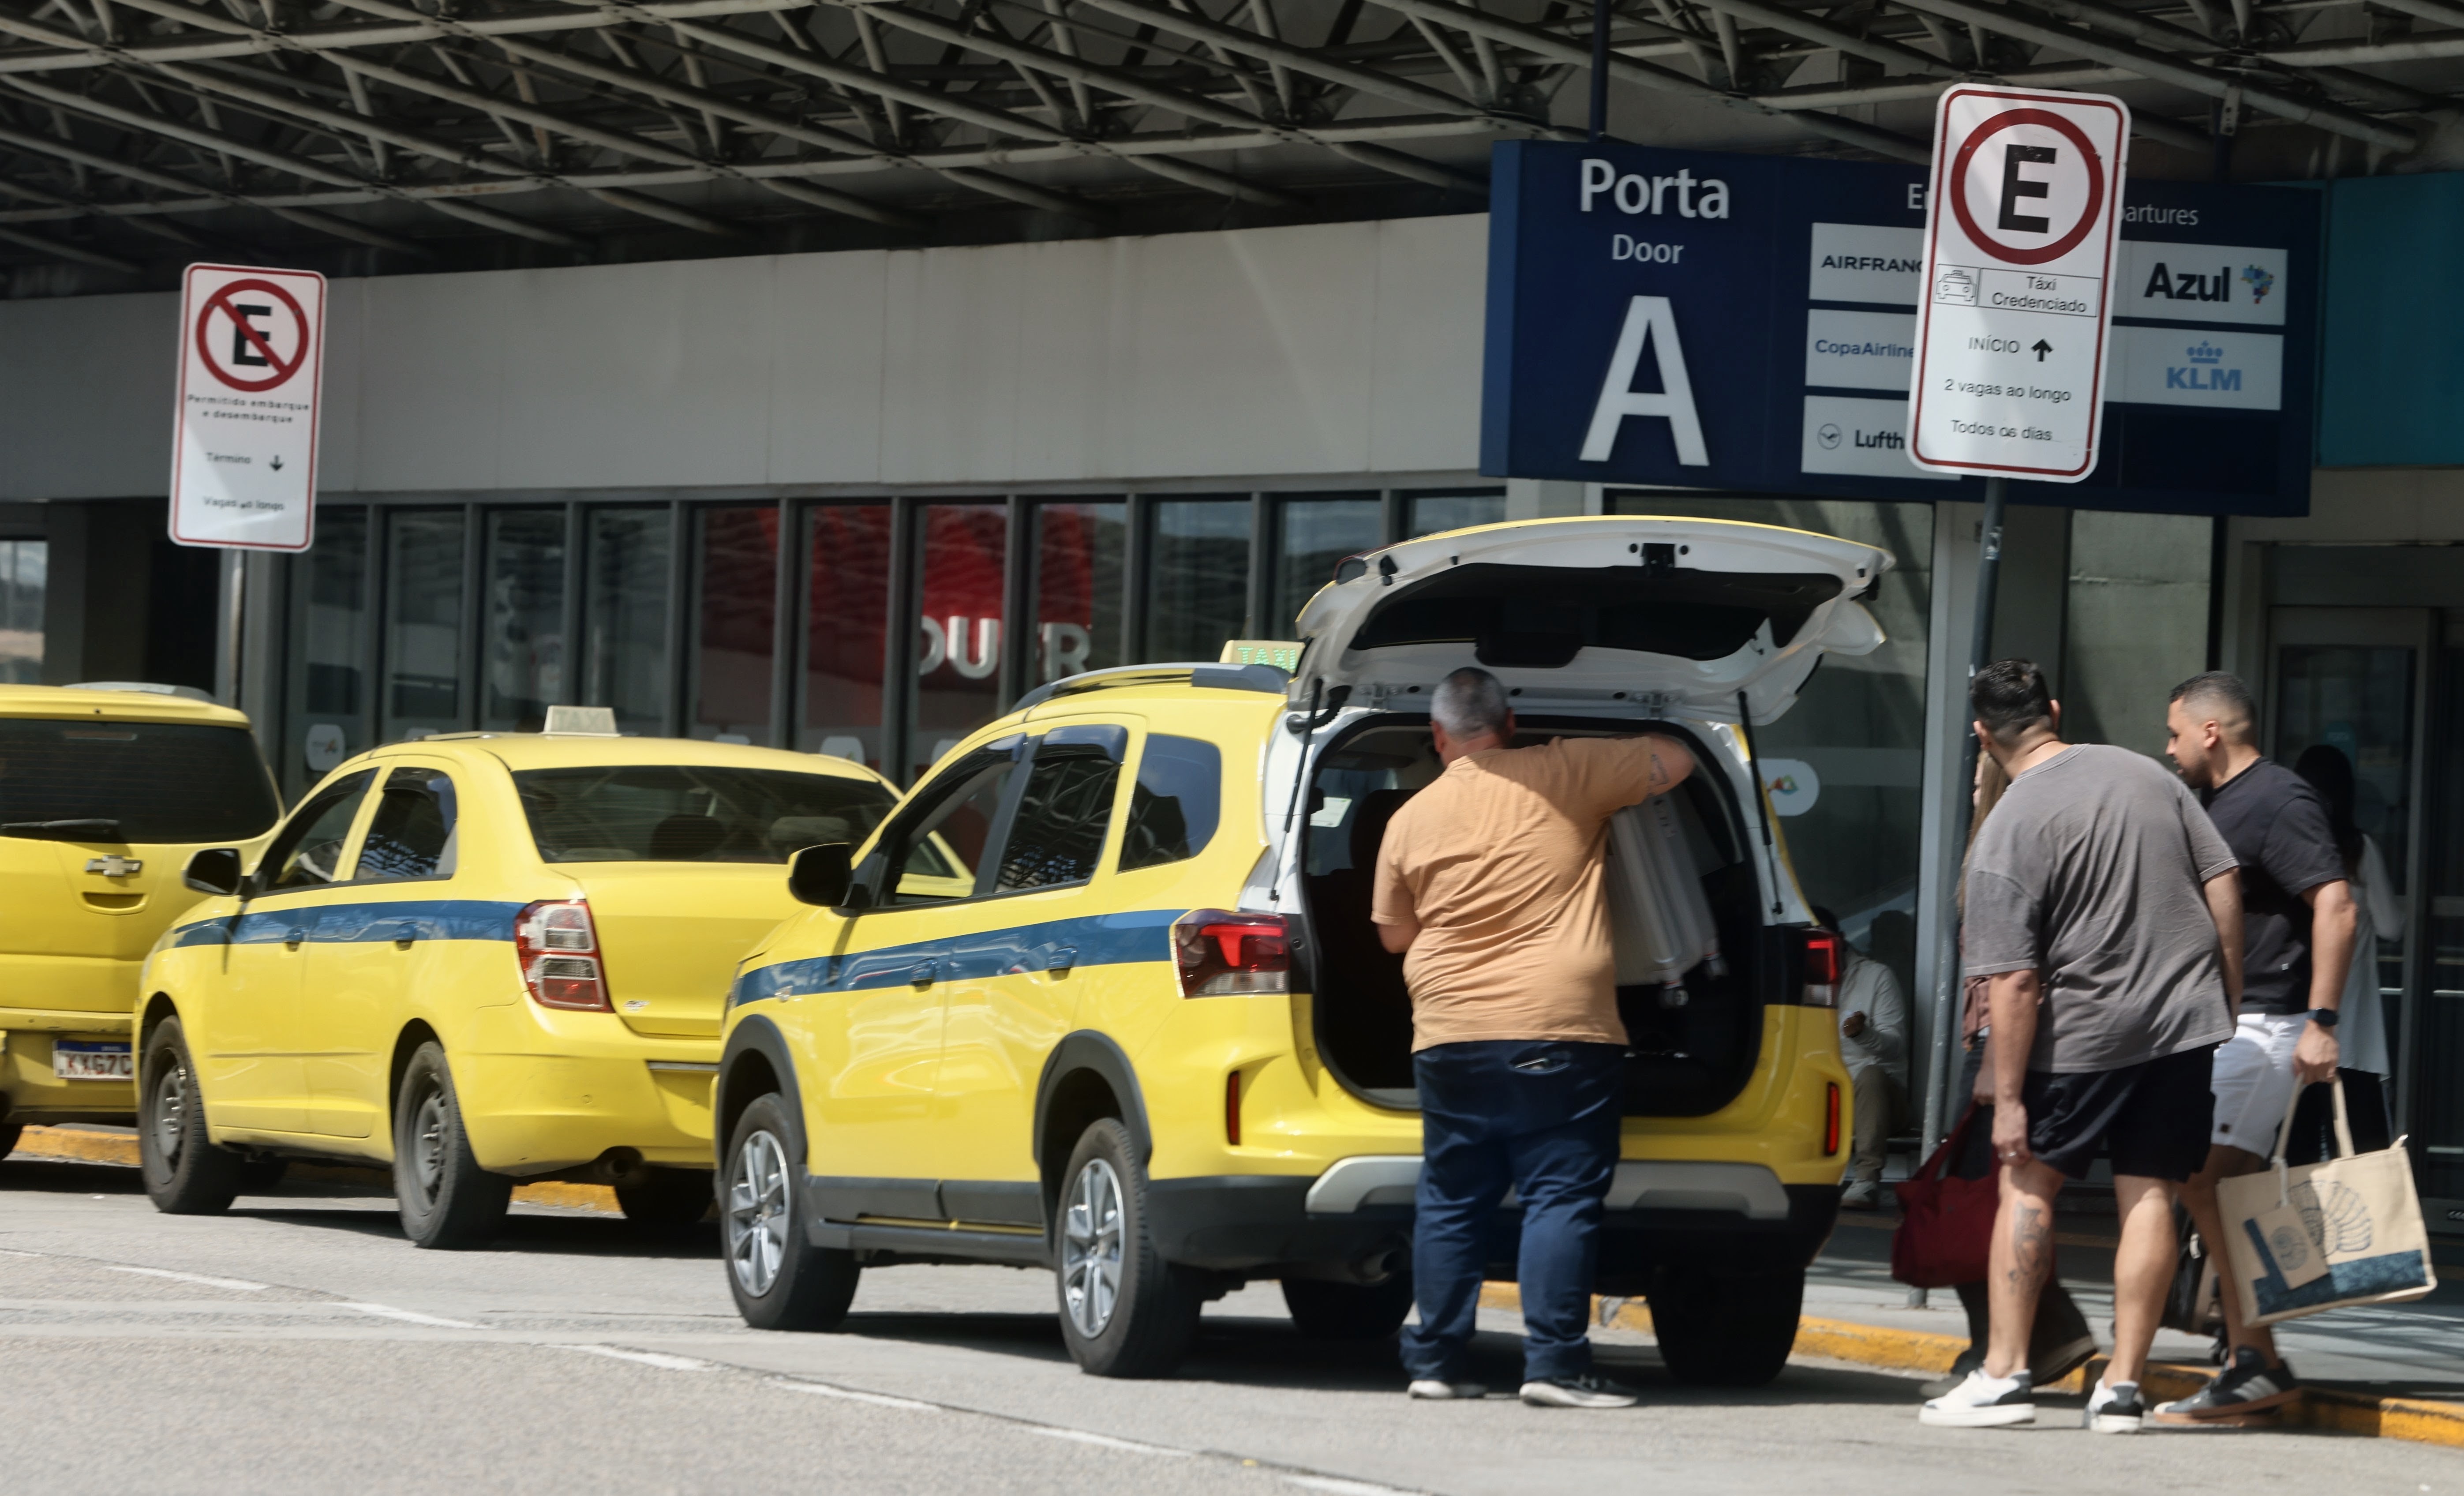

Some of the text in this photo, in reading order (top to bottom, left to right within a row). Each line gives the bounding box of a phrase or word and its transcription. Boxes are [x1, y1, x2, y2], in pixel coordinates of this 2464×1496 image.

[1581, 158, 1730, 219] Porta
[1998, 144, 2057, 234] E
[2122, 204, 2198, 226] artures
[1612, 234, 1684, 264] Door
[2027, 276, 2057, 291] Táxi
[2144, 263, 2231, 302] Azul
[1992, 292, 2087, 312] Credenciado
[233, 304, 272, 367] E
[1968, 335, 2020, 353] INÍCIO
[1579, 295, 1710, 467] A
[2166, 367, 2242, 391] KLM
[1944, 379, 2071, 403] 2 vagas ao longo
[187, 394, 309, 411] Permitido embarque
[213, 411, 292, 423] desembarque
[1856, 429, 1905, 450] Lufth
[1951, 420, 2052, 441] Todos os dias
[203, 496, 237, 510] Vagas
[1237, 647, 1296, 670] TAXI
